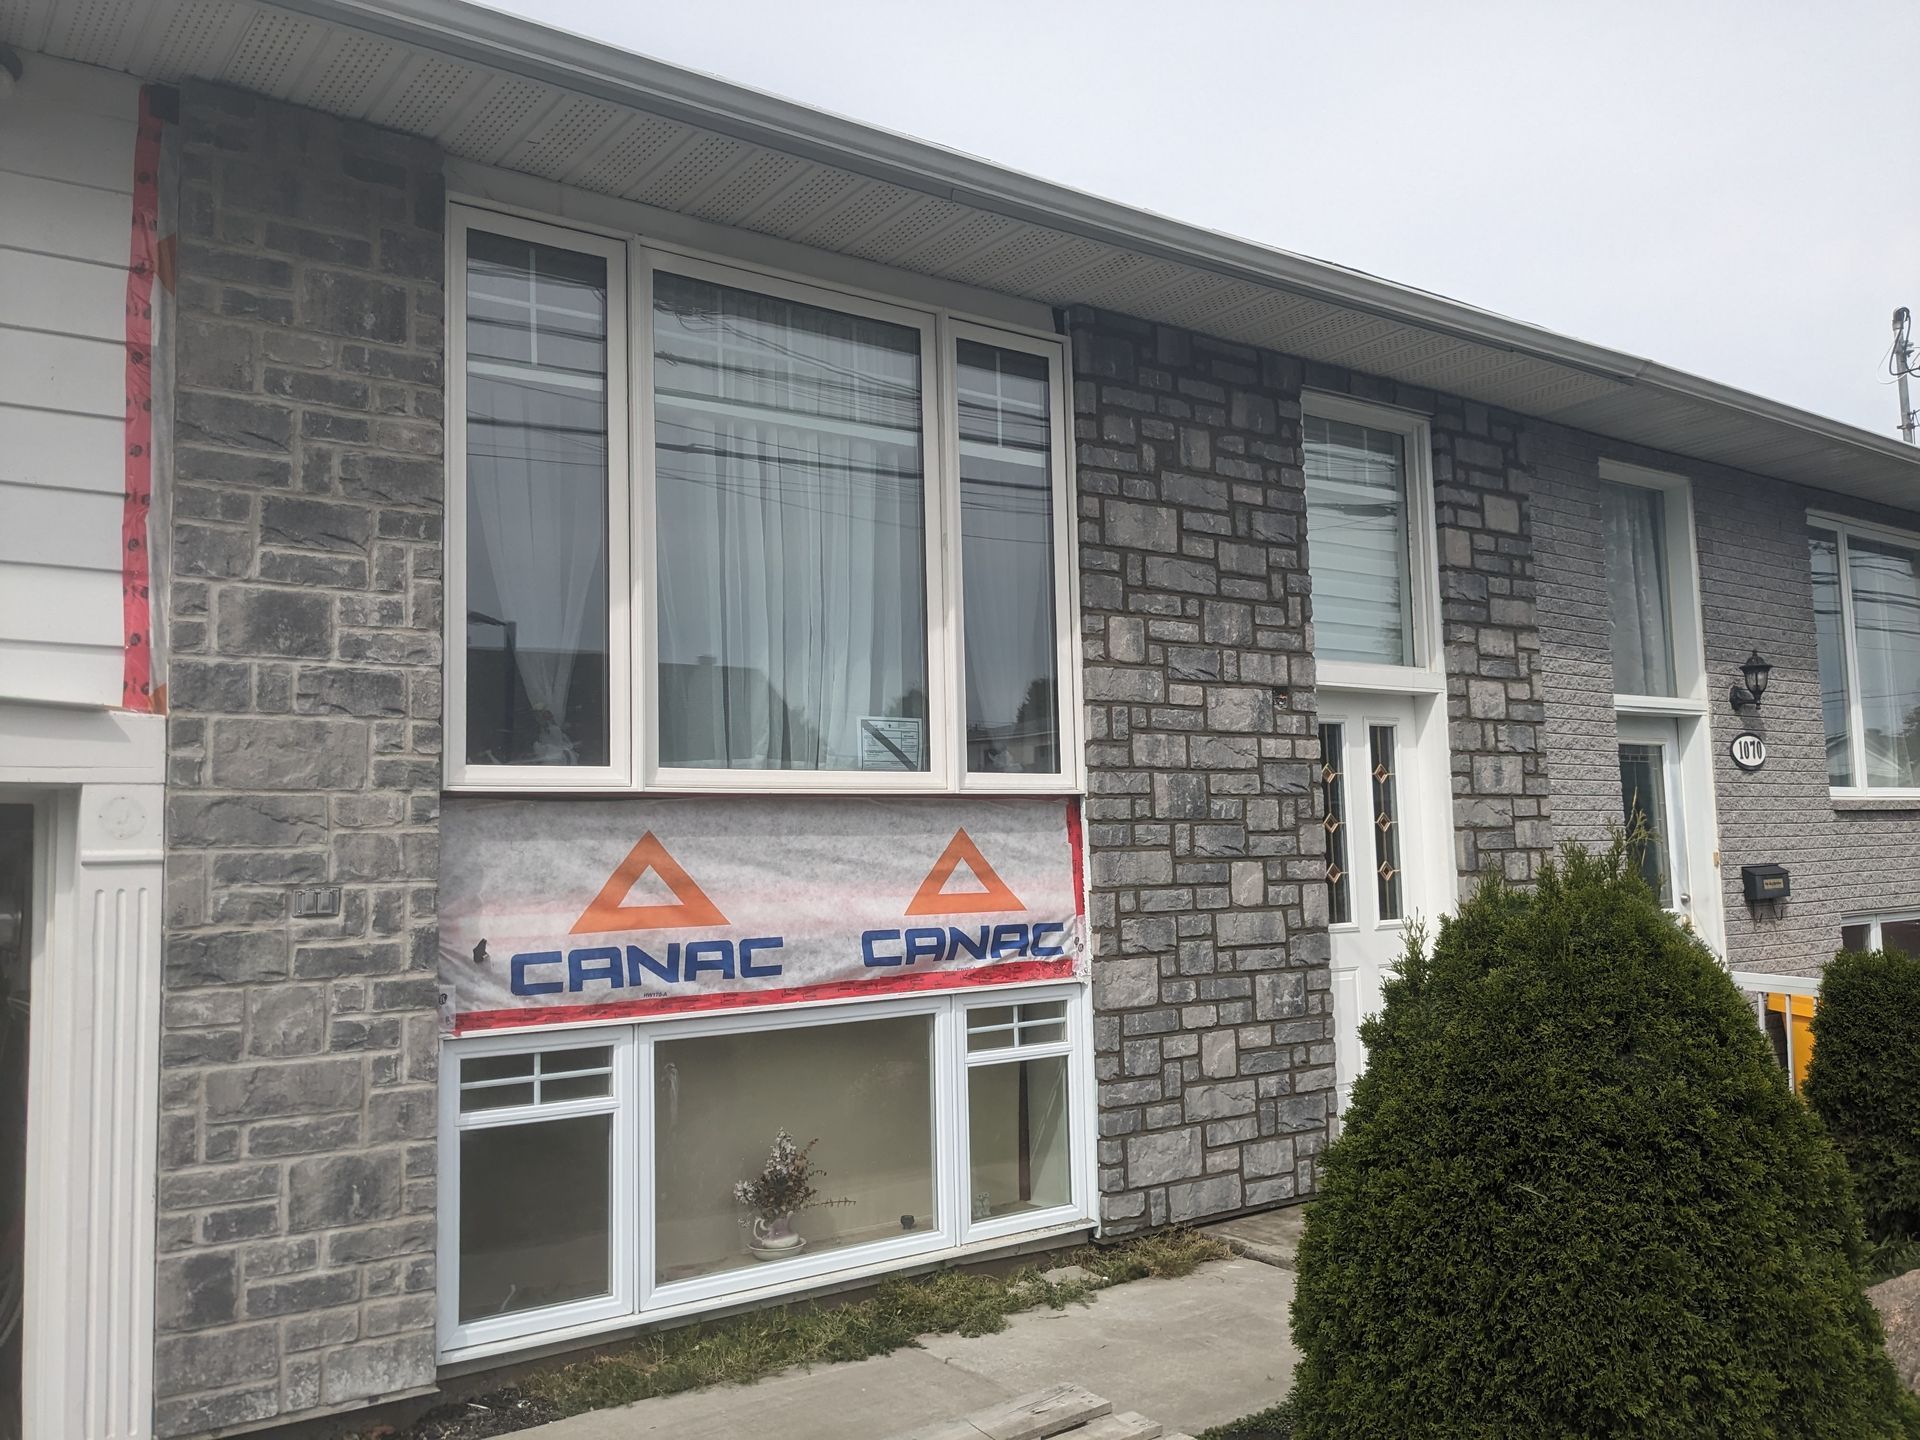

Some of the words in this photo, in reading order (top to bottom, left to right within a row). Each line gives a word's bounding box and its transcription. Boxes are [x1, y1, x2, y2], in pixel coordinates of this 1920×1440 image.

[1739, 740, 1762, 759] 1070
[511, 937, 784, 996] CANAC
[861, 922, 1064, 967] CANAC
